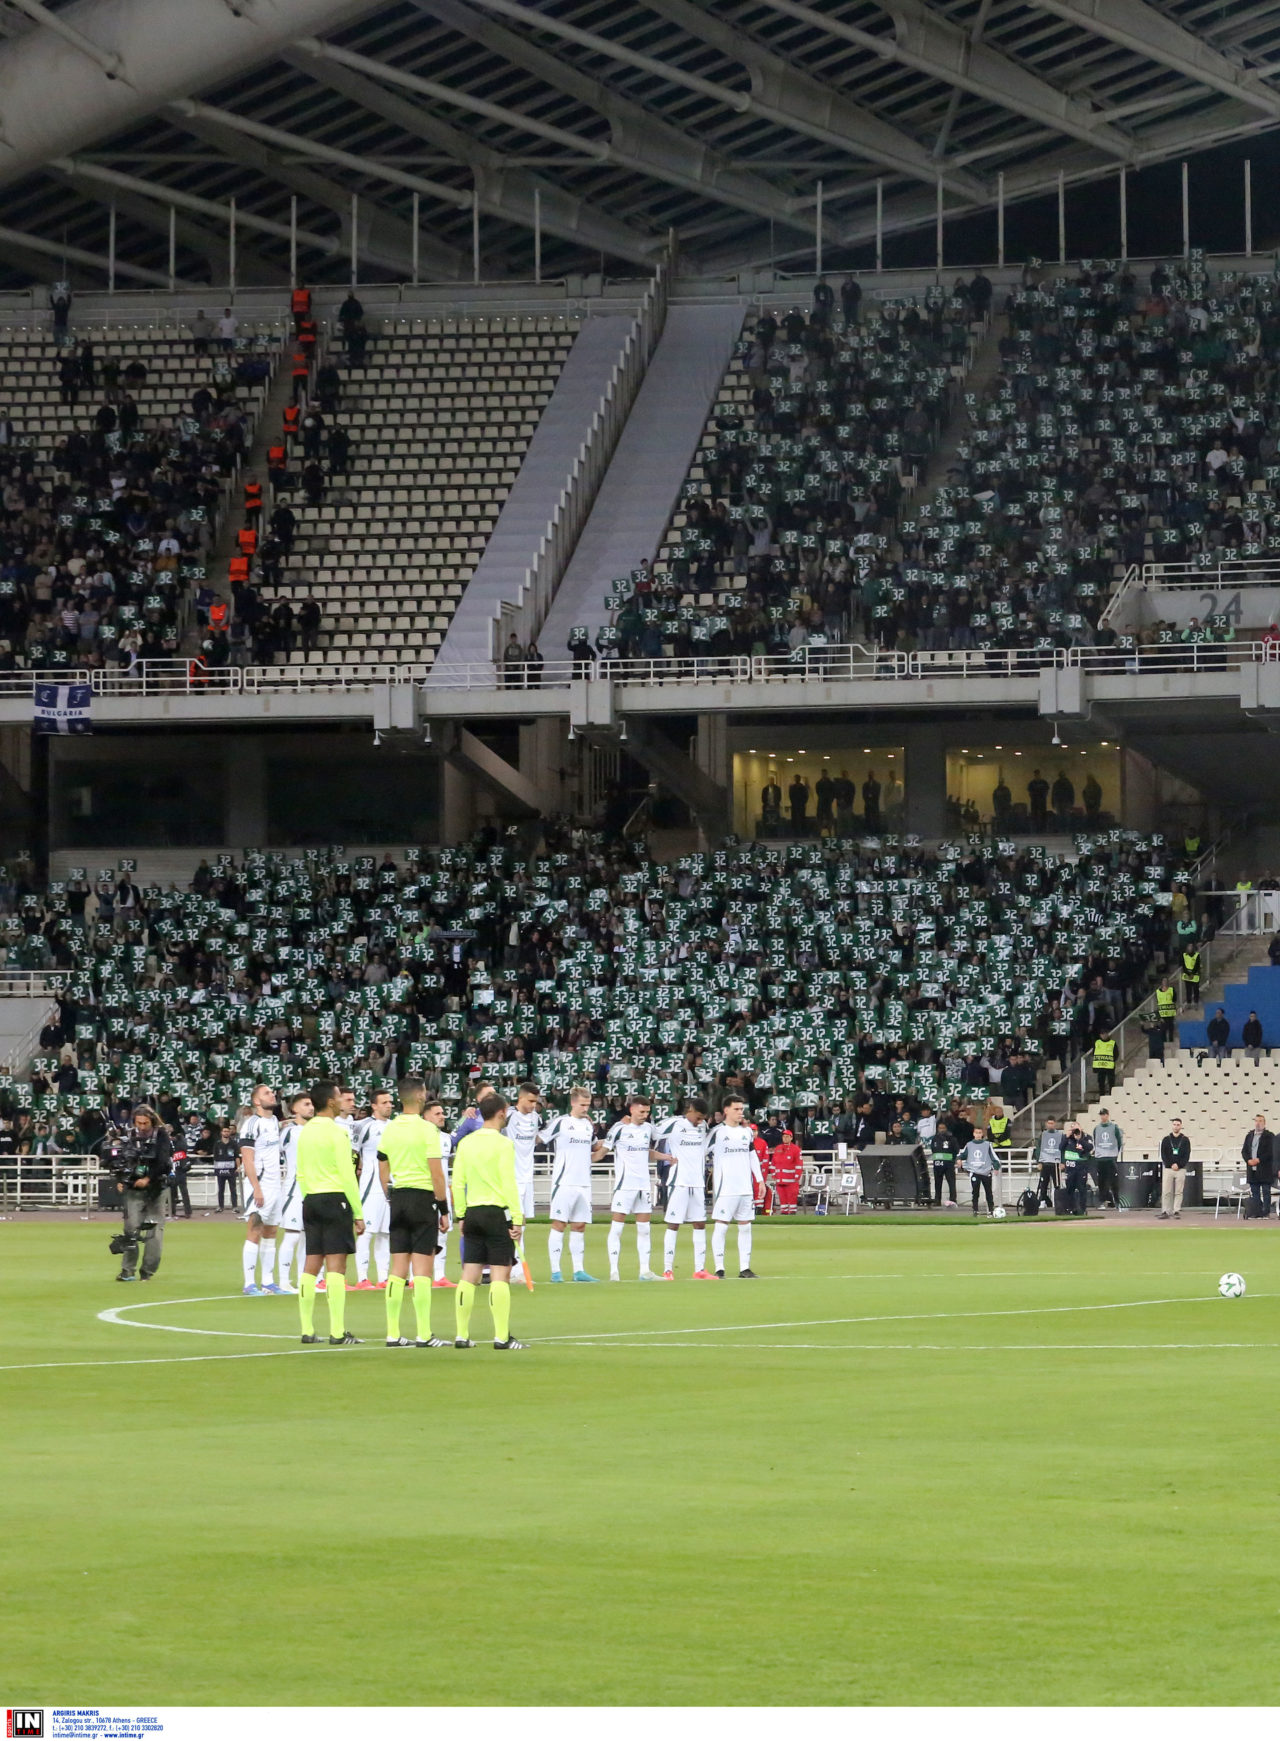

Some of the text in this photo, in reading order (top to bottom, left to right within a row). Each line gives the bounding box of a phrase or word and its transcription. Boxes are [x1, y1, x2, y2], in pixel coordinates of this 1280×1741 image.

[1210, 417, 1220, 428] 32
[1247, 510, 1259, 521] 32
[903, 522, 915, 532] 32
[1269, 537, 1280, 547] 32
[673, 548, 684, 558] 32
[616, 580, 627, 592] 32
[1082, 584, 1094, 595] 32
[876, 606, 887, 617] 32
[1200, 592, 1243, 625] 24
[604, 628, 615, 638] 32
[666, 622, 678, 633] 32
[1160, 631, 1172, 642] 32
[54, 651, 66, 661] 32
[41, 709, 83, 717] BULGARIA
[569, 877, 581, 888] 32
[714, 872, 726, 882] 32
[731, 878, 743, 889] 32
[887, 880, 898, 891] 32
[999, 882, 1010, 894] 32
[957, 887, 969, 898] 32
[741, 914, 752, 925] 32
[187, 929, 198, 940] 32
[954, 925, 966, 939] 32
[1056, 932, 1067, 944] 32
[772, 939, 784, 950] 32
[841, 934, 853, 945] 32
[1021, 936, 1033, 947] 32
[977, 940, 987, 952] 32
[1107, 946, 1120, 957] 32
[422, 949, 434, 960] 32
[772, 955, 785, 966] 32
[132, 961, 144, 972] 32
[622, 963, 634, 975] 32
[1032, 965, 1044, 976] 32
[691, 968, 703, 980] 32
[783, 970, 797, 982] 32
[917, 968, 929, 980] 32
[424, 976, 436, 987] 32
[854, 978, 866, 989] 32
[957, 975, 970, 986] 32
[1000, 979, 1012, 991] 32
[673, 988, 684, 999] 32
[808, 985, 821, 997] 32
[106, 994, 118, 1006] 32
[555, 992, 567, 1003] 32
[494, 1001, 507, 1013] 32
[570, 998, 582, 1010] 32
[521, 1005, 534, 1017] 32
[112, 1019, 124, 1030] 32
[358, 1017, 369, 1029] 32
[547, 1016, 559, 1030] 32
[1020, 1014, 1031, 1026] 32
[424, 1023, 438, 1035] 32
[800, 1028, 813, 1040] 32
[832, 1028, 845, 1040] 32
[912, 1028, 925, 1040] 32
[998, 1022, 1011, 1034] 32
[320, 1035, 332, 1046] 32
[638, 1031, 650, 1043] 32
[819, 1039, 831, 1051] 32
[981, 1038, 994, 1050] 32
[186, 1051, 199, 1062] 32
[609, 1047, 622, 1060] 32
[804, 1045, 817, 1057] 32
[228, 1060, 241, 1072] 32
[409, 1059, 422, 1072] 32
[537, 1054, 550, 1066] 32
[741, 1058, 754, 1070] 32
[785, 1062, 799, 1075] 32
[124, 1071, 137, 1083] 32
[657, 1080, 670, 1093] 32
[806, 1078, 820, 1091] 32
[117, 1085, 130, 1097] 32
[18, 1096, 32, 1108] 32
[87, 1096, 100, 1108] 32
[185, 1098, 199, 1110] 32
[815, 1121, 829, 1133] 32
